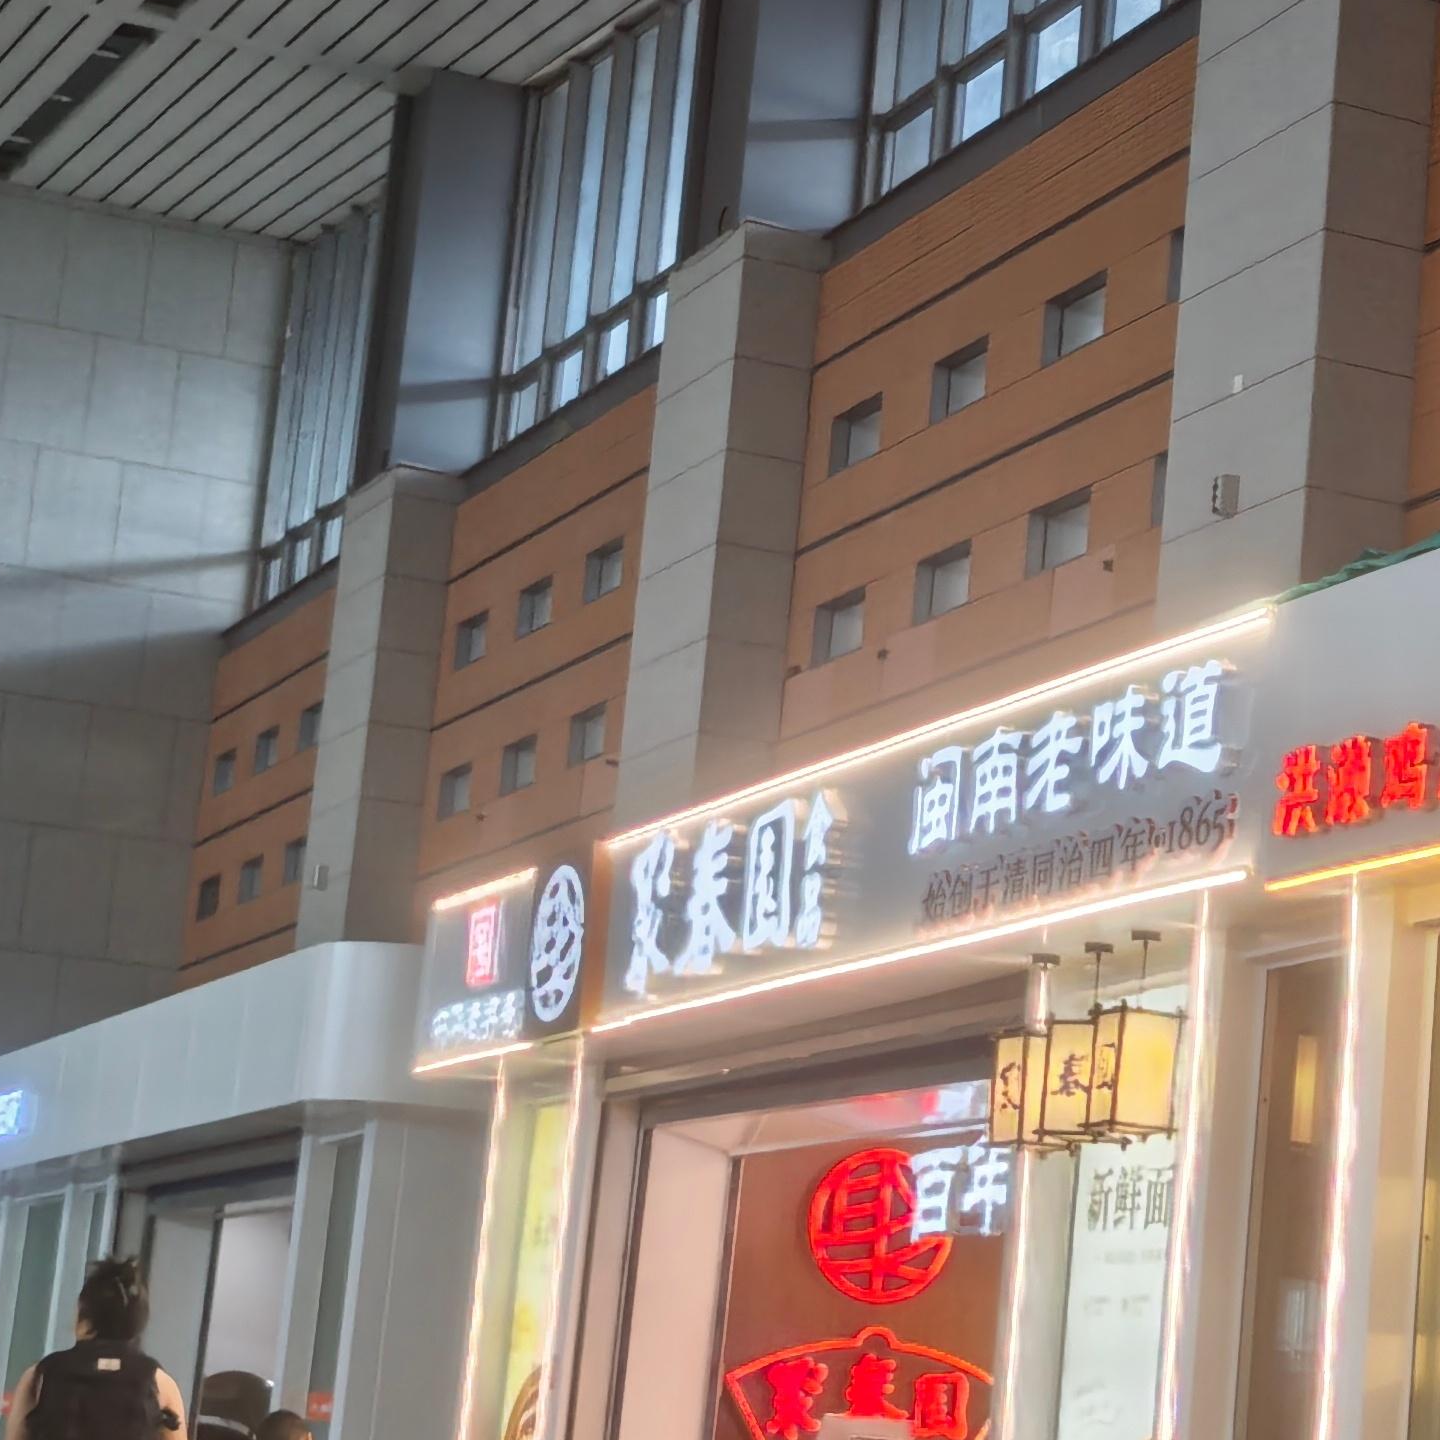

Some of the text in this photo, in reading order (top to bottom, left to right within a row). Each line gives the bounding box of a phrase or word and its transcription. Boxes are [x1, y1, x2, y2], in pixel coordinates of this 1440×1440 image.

[909, 659, 1224, 856] 闽南老味道
